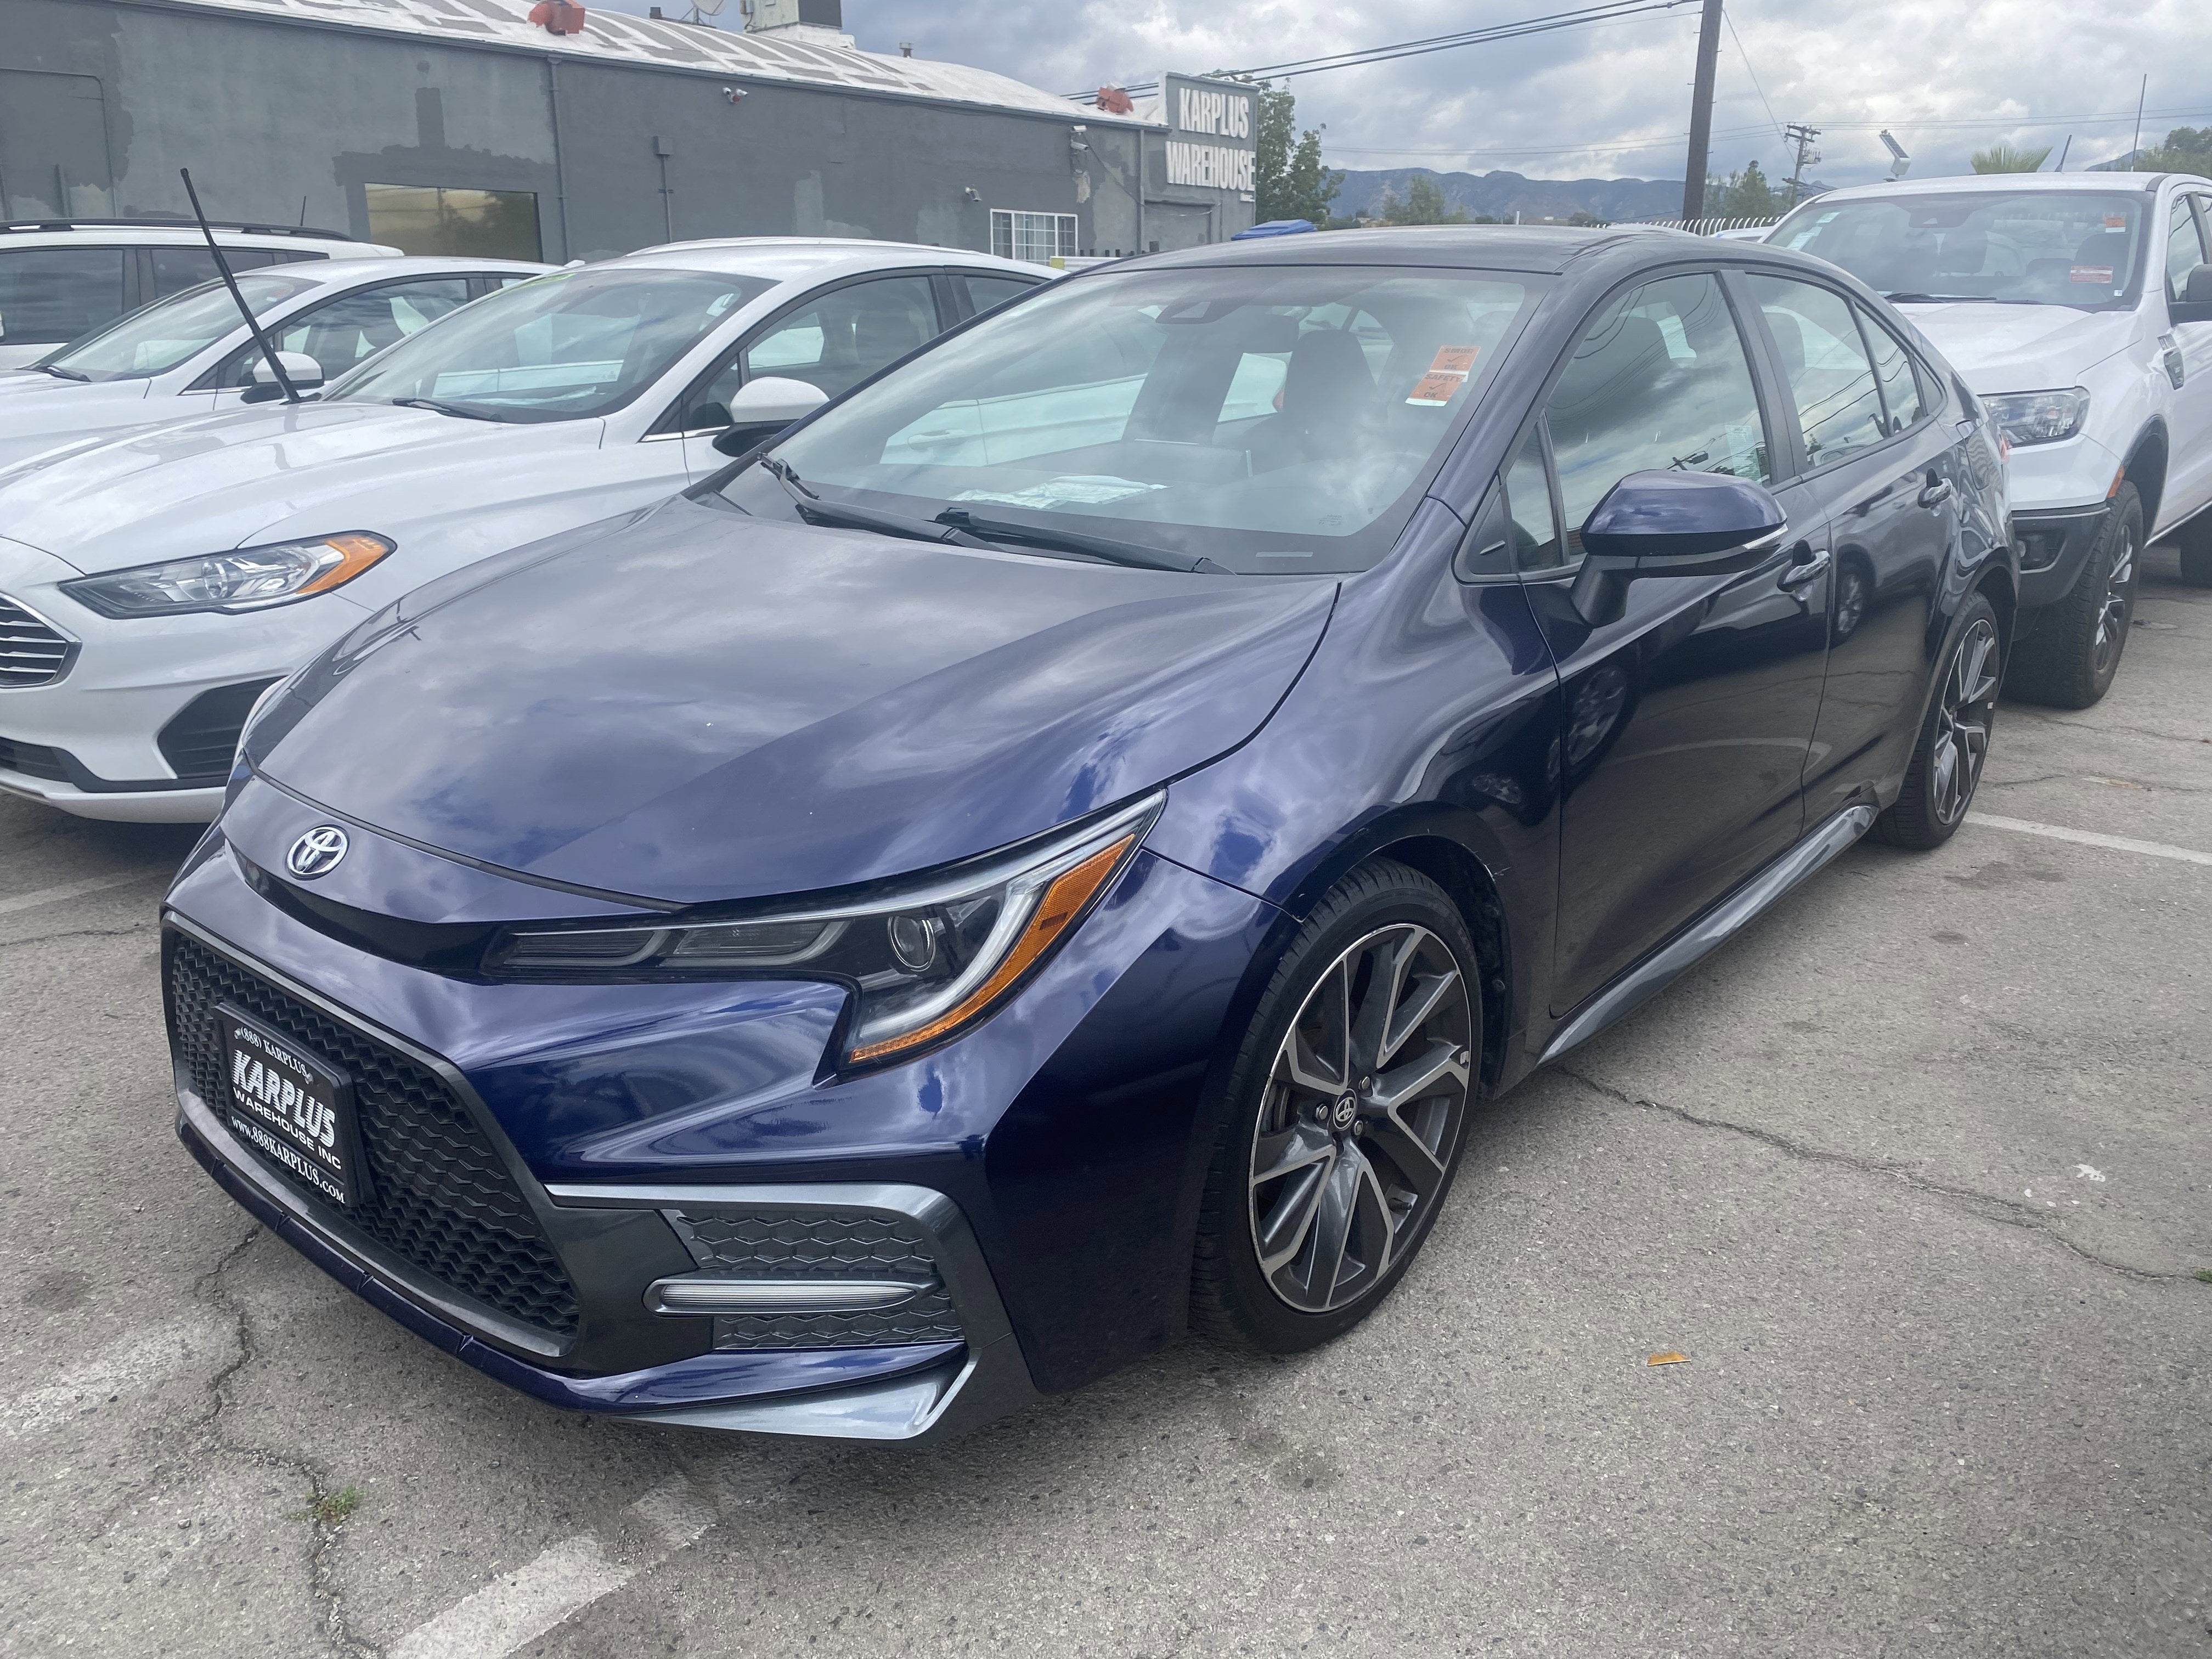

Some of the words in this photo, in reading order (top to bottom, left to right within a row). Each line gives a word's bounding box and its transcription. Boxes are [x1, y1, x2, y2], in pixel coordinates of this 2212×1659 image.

[1178, 88, 1249, 138] KARPLUS
[1166, 141, 1256, 191] WAREHOUSE
[240, 1026, 262, 1049] (888)
[263, 1040, 307, 1076] KARPLUS
[232, 1049, 335, 1148] KARPLUS
[233, 1087, 314, 1152] WAREHOUSE
[318, 1146, 341, 1170] INC
